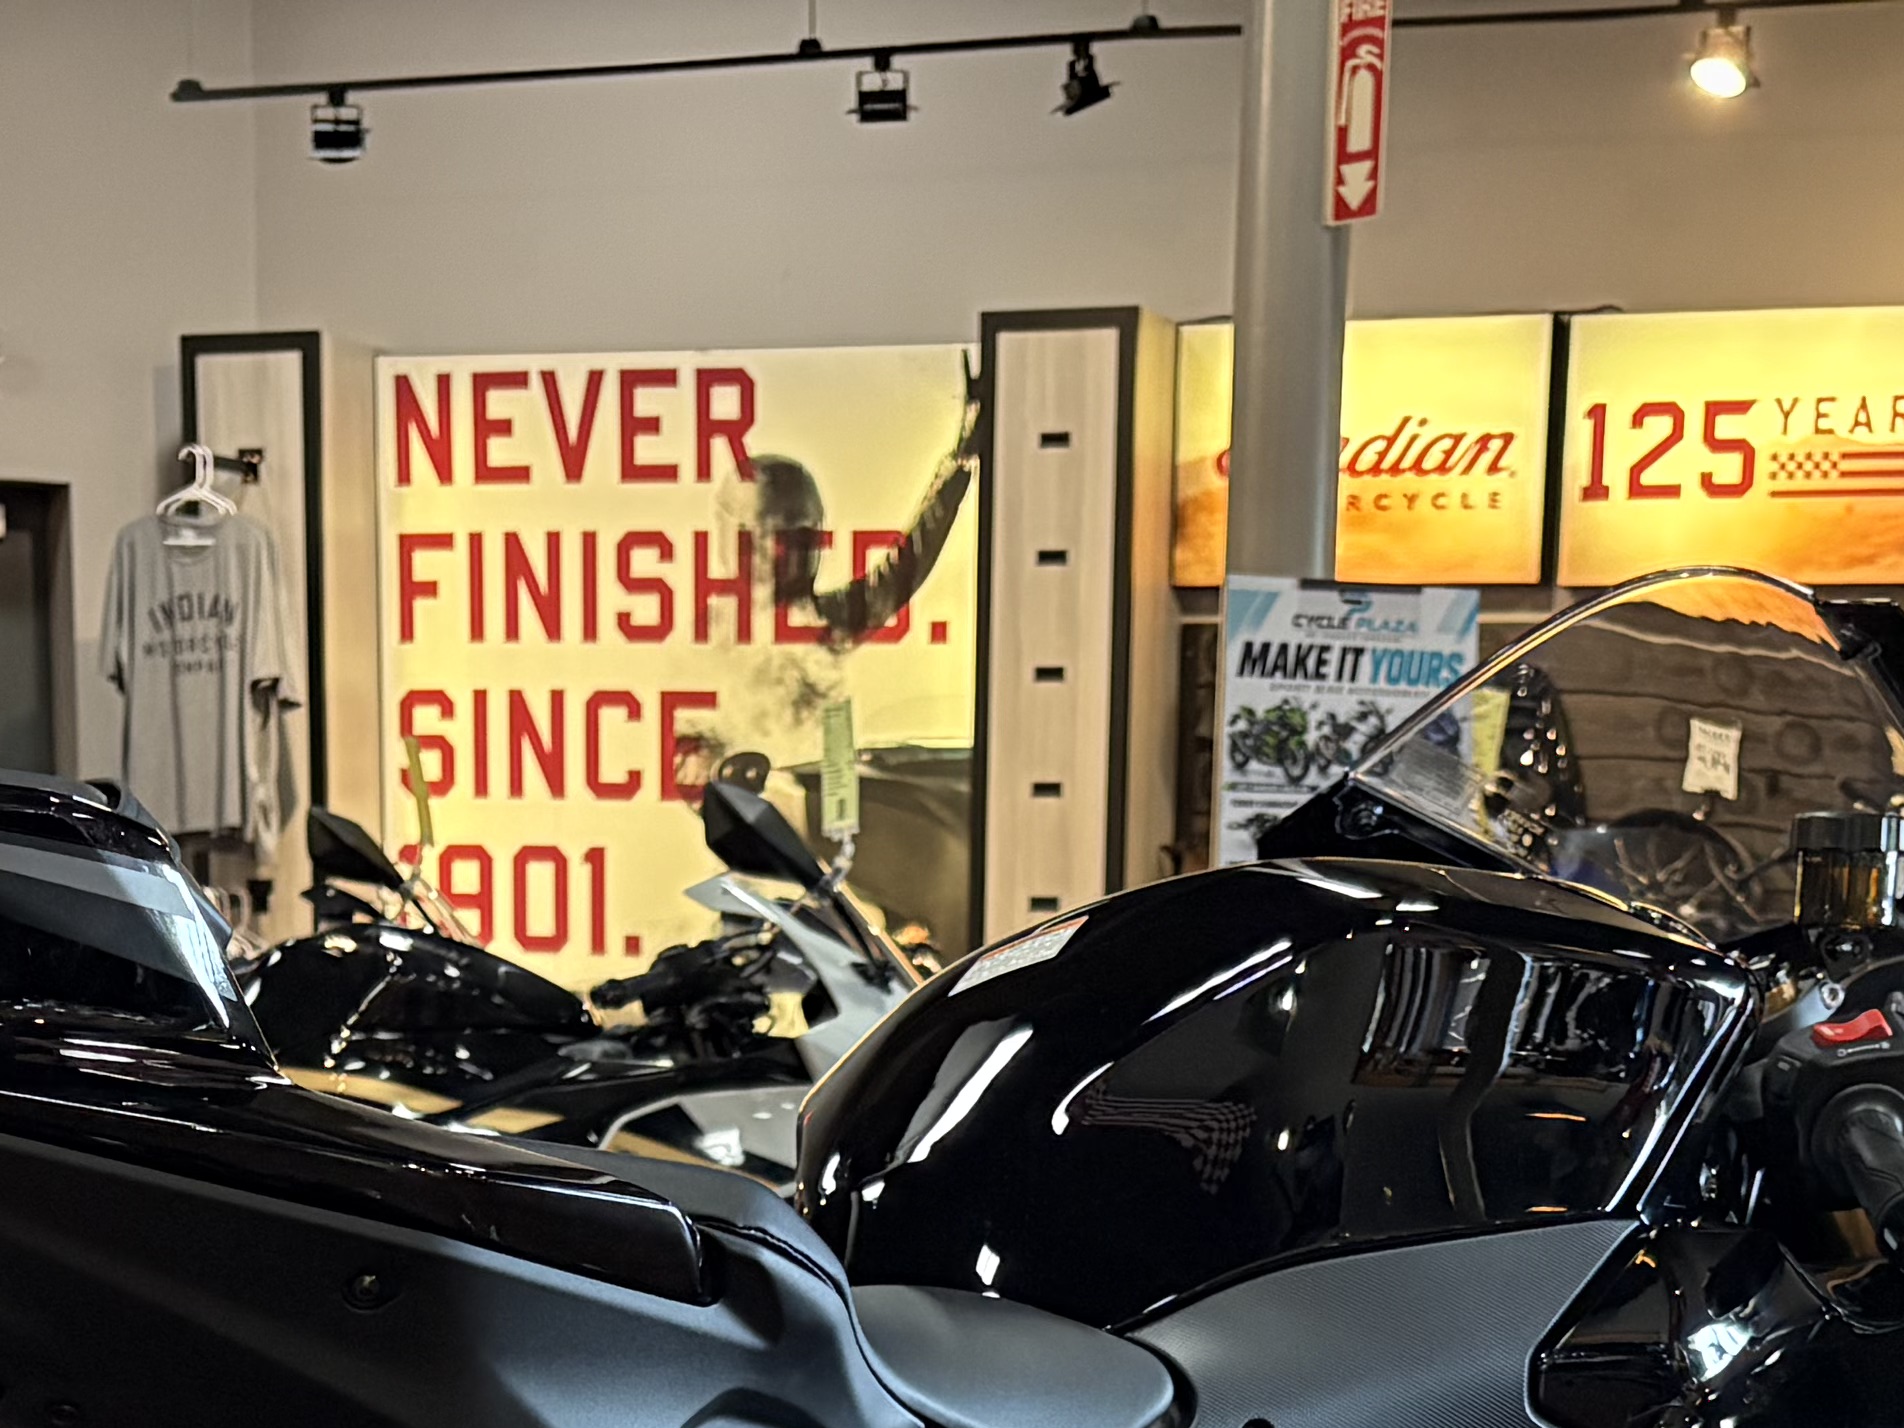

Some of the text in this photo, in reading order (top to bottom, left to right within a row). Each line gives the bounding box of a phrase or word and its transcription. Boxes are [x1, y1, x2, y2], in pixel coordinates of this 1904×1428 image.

[395, 367, 756, 487] NEVER
[1217, 415, 1516, 478] dian
[1579, 399, 1757, 502] 125
[1345, 491, 1503, 512] RCYCLE
[1236, 641, 1465, 687] MAKE IT YOURS
[1291, 613, 1420, 634] CYCLE PLAZA
[399, 689, 718, 802] SINCE
[399, 844, 644, 958] 901.
